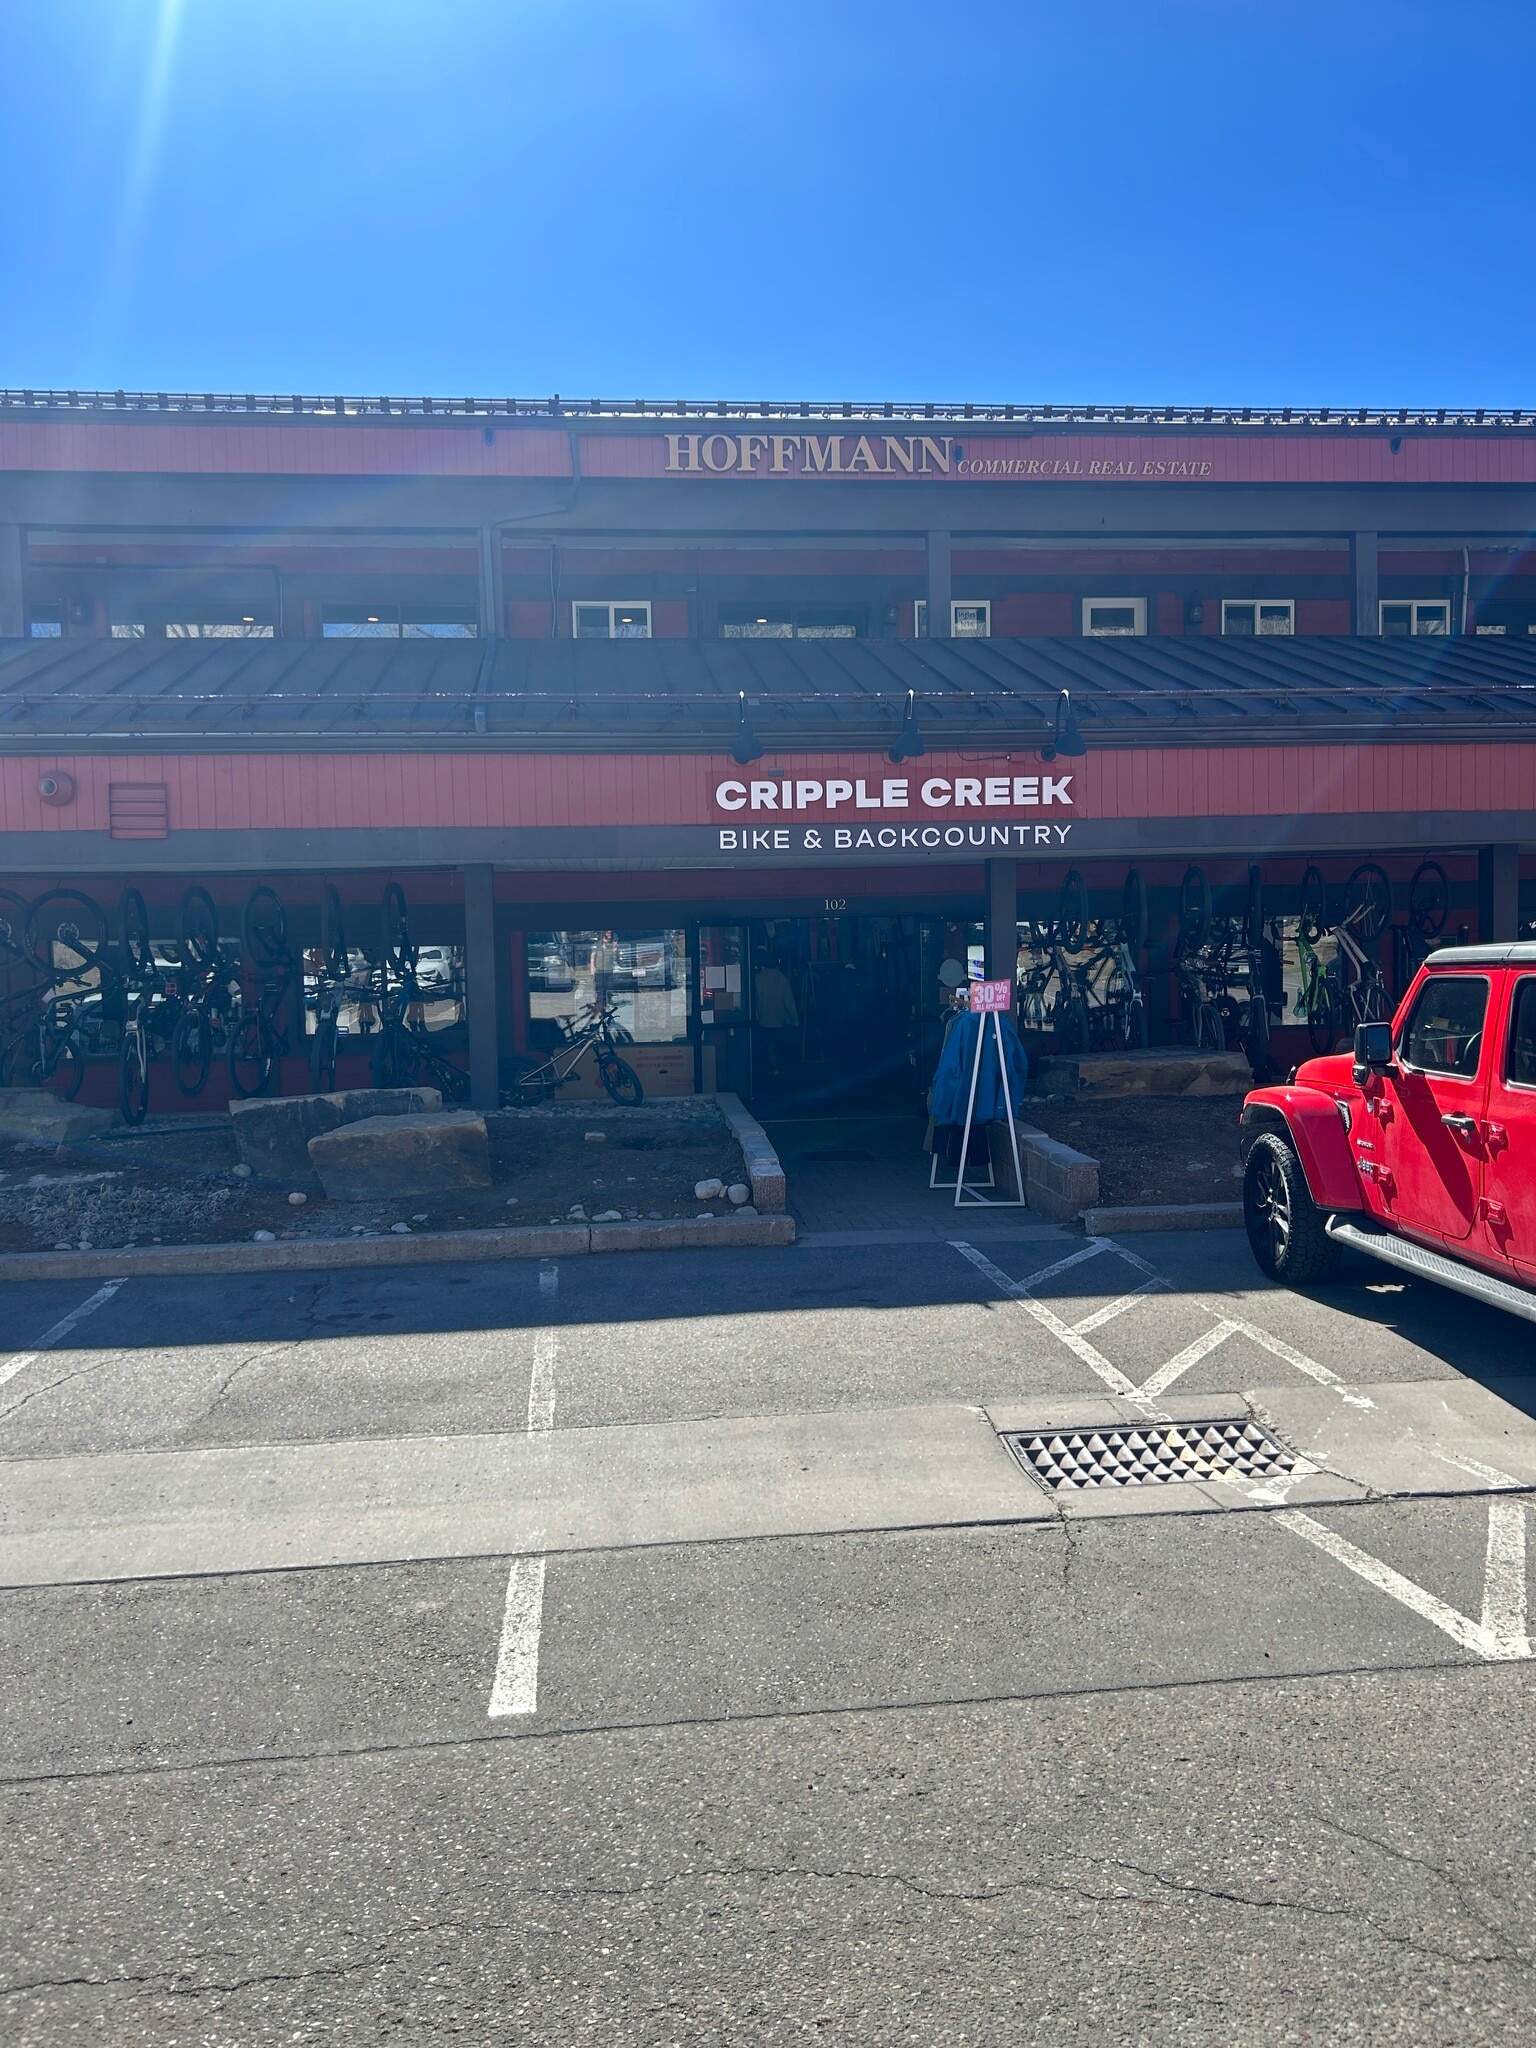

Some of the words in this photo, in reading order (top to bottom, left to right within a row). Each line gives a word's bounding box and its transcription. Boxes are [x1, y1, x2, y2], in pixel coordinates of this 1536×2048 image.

[664, 434, 953, 473] HOFFMANN
[957, 459, 1083, 475] COMMERCIAL
[1088, 461, 1138, 475] REAL
[1141, 461, 1212, 476] ESTATE
[715, 778, 909, 811] CRIPPLE
[920, 775, 1074, 808] CREEK
[719, 829, 791, 850] BIKE
[803, 829, 823, 849] &
[834, 825, 1073, 849] BACKCOUNTRY
[825, 899, 847, 910] 102
[1357, 1156, 1373, 1173] Jeep
